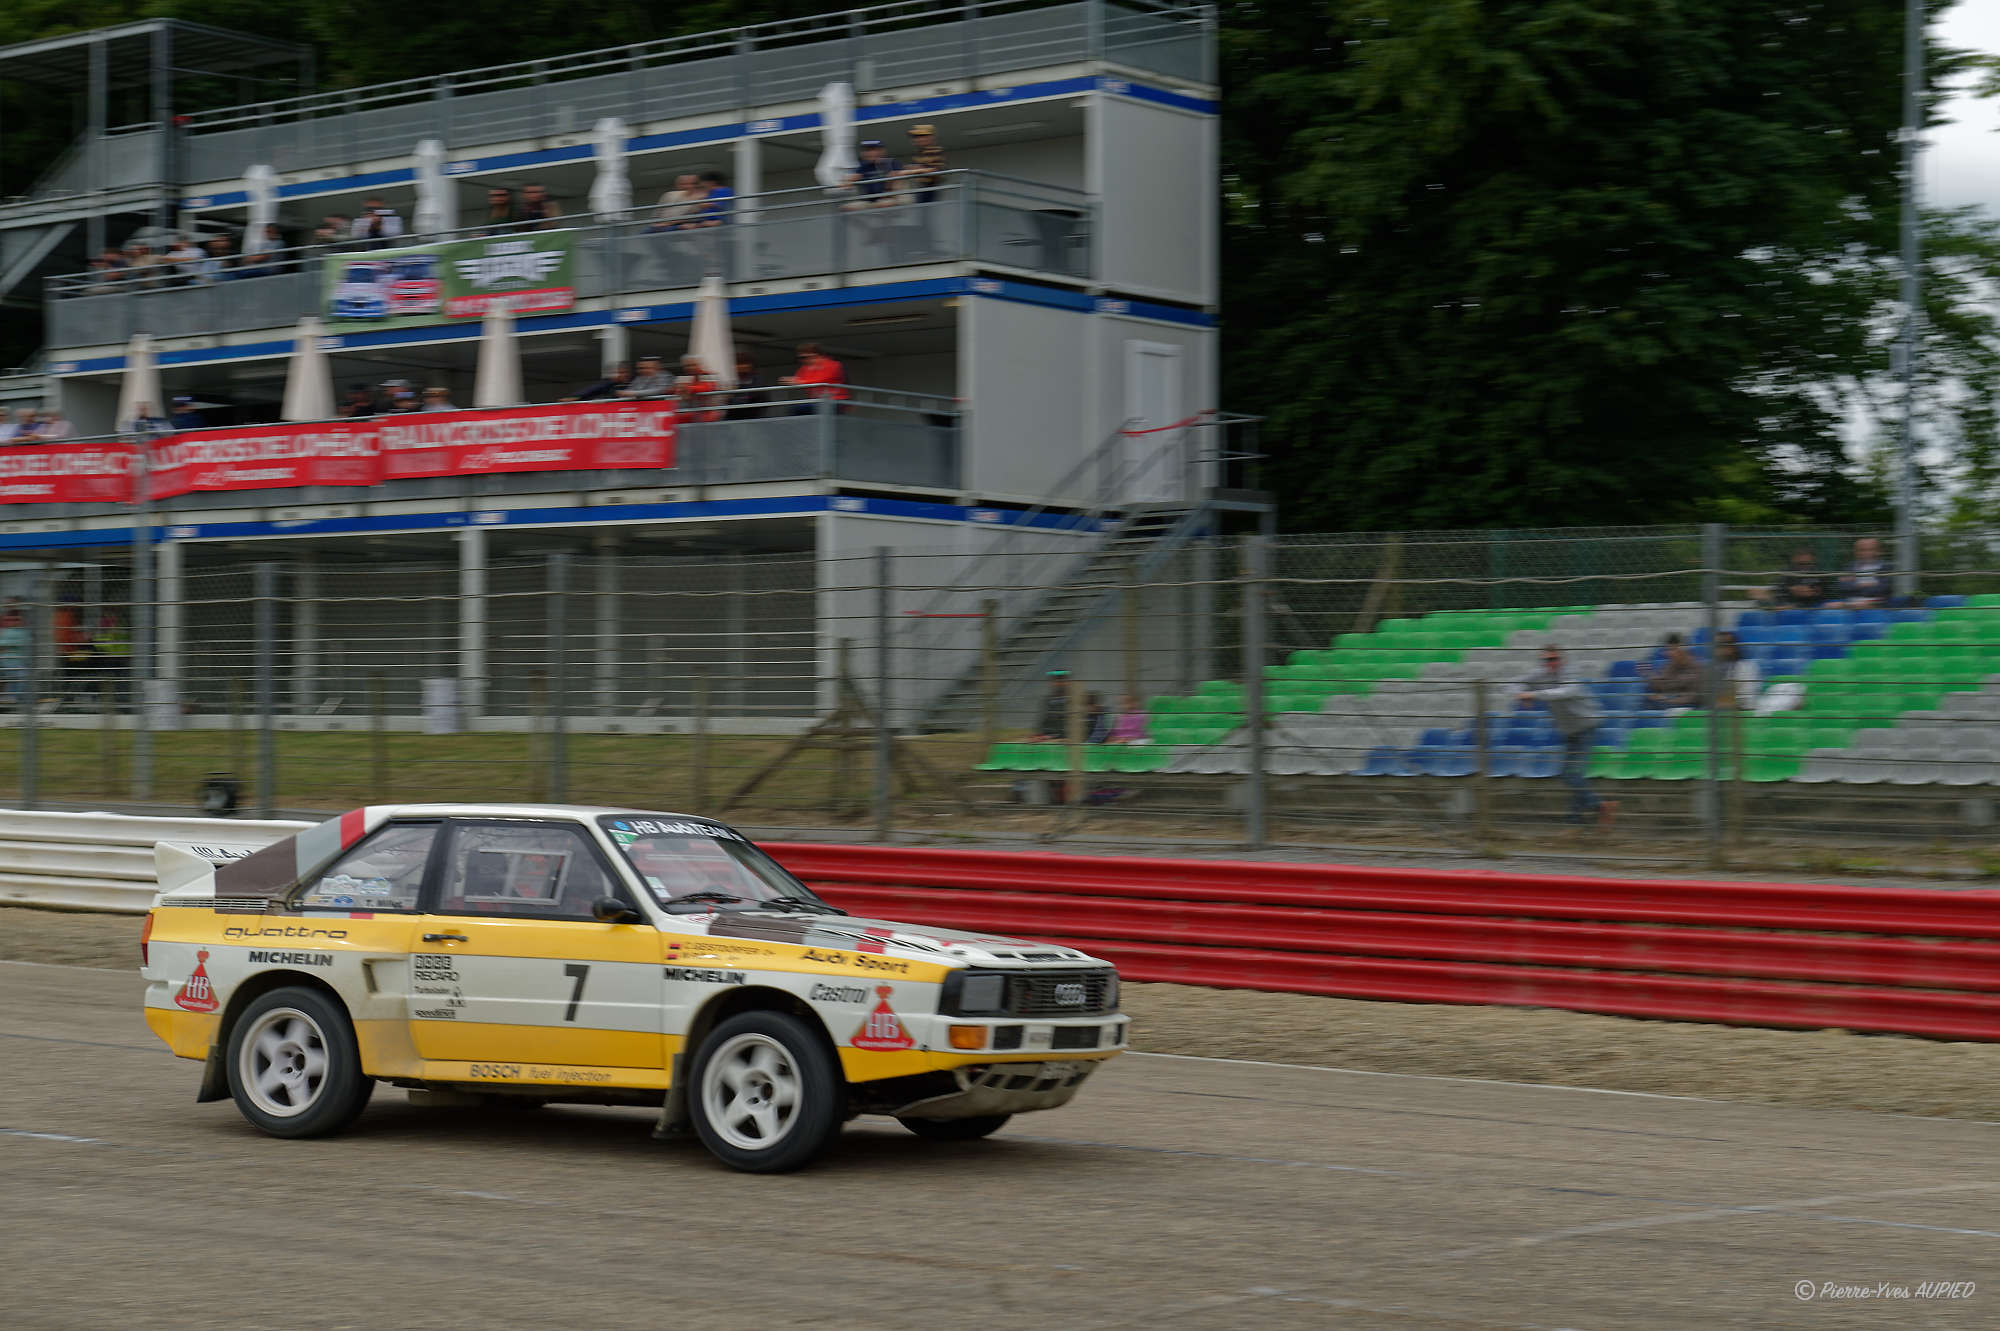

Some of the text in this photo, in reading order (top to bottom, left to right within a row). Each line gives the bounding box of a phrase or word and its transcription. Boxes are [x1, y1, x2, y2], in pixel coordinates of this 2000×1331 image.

[630, 821, 660, 834] HB
[225, 926, 347, 939] quattro
[249, 951, 333, 966] MICHELIN
[801, 949, 910, 974] Audi Sport
[415, 970, 459, 982] RECARO
[664, 967, 746, 985] MICHELIN
[186, 975, 209, 1000] HB
[563, 963, 590, 1022] 7
[811, 983, 869, 1003] Castrol
[866, 1013, 899, 1039] HB
[469, 1063, 521, 1079] BOSCH
